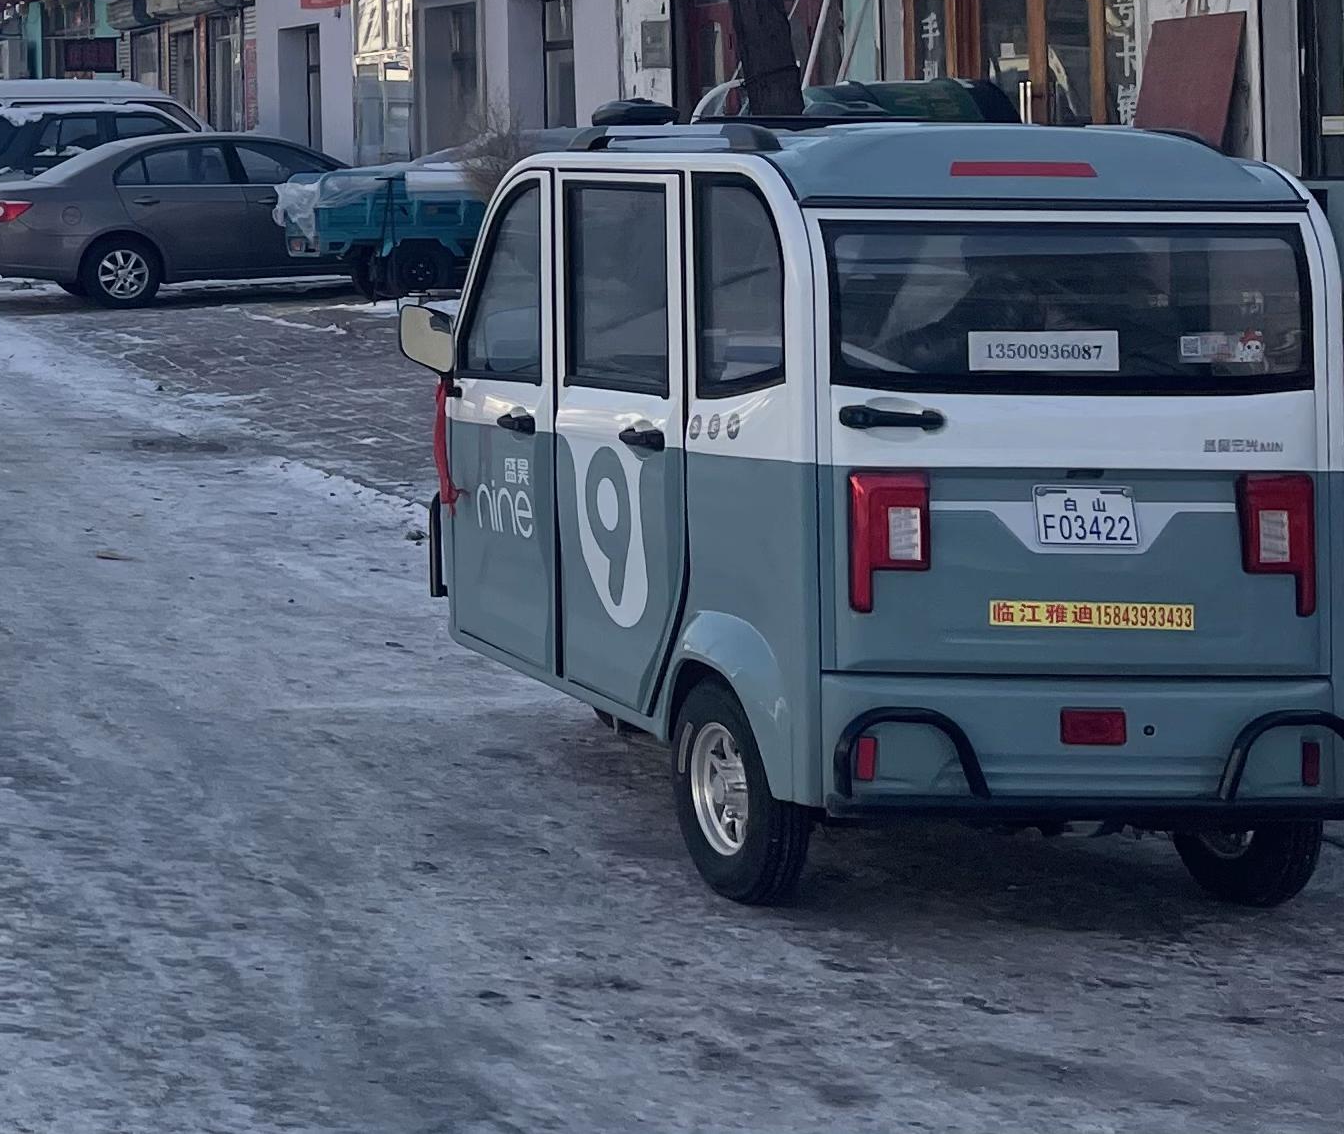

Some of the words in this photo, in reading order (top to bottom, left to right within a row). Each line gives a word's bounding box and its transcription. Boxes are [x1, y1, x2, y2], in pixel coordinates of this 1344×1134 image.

[984, 343, 1103, 361] 13500936087
[504, 457, 530, 486] 盛昊
[476, 479, 533, 538] nine
[1063, 497, 1107, 513] 白山
[1042, 513, 1133, 541] F03422
